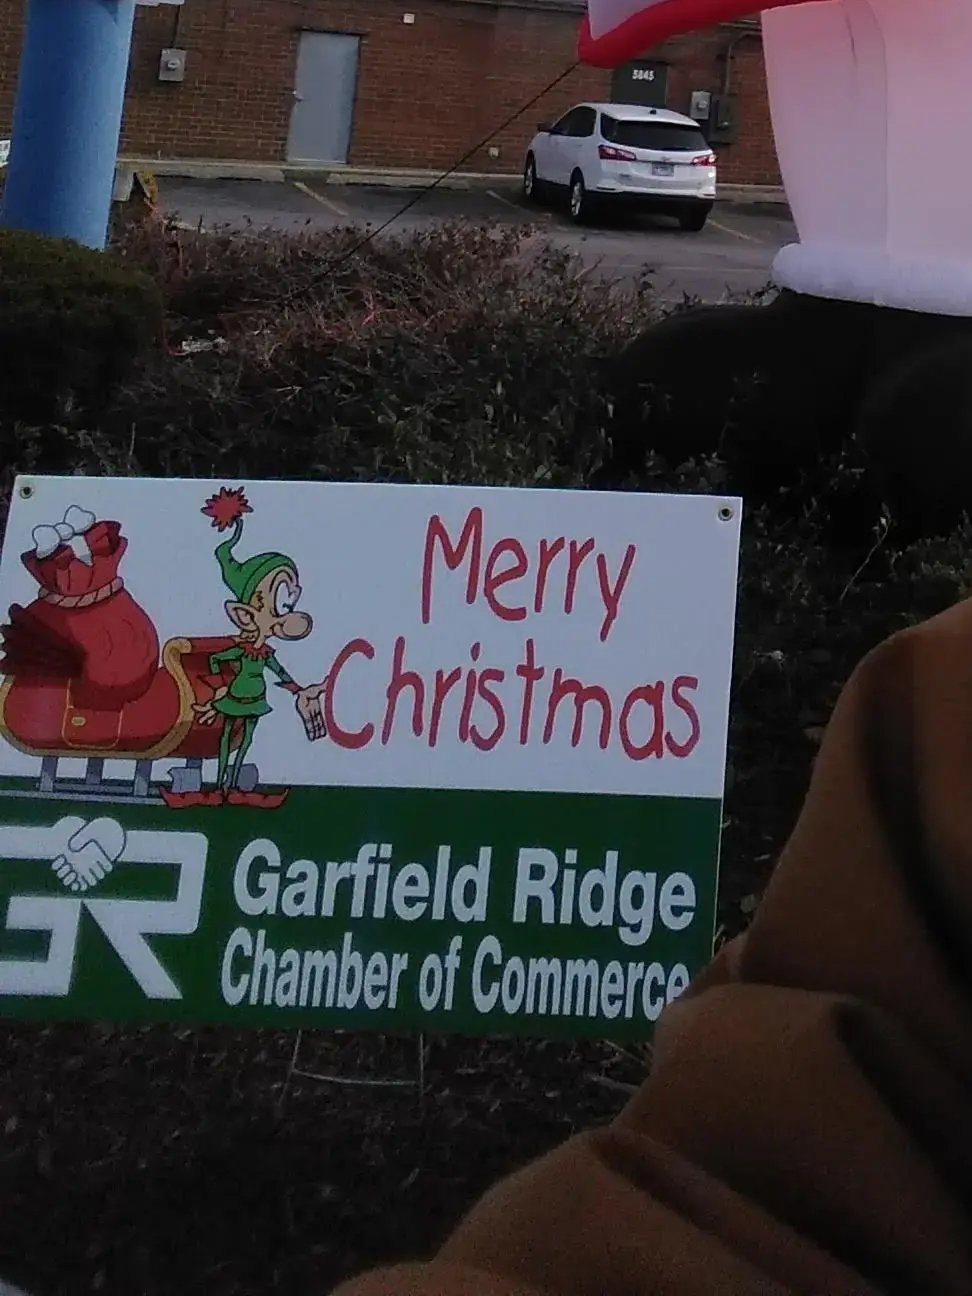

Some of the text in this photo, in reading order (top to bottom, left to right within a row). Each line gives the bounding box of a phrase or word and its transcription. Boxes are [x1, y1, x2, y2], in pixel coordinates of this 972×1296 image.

[421, 506, 636, 642] Merry
[325, 636, 700, 761] Christmas
[233, 838, 697, 947] Garfield Ridge
[221, 926, 691, 1021] Chamber of Commerce
